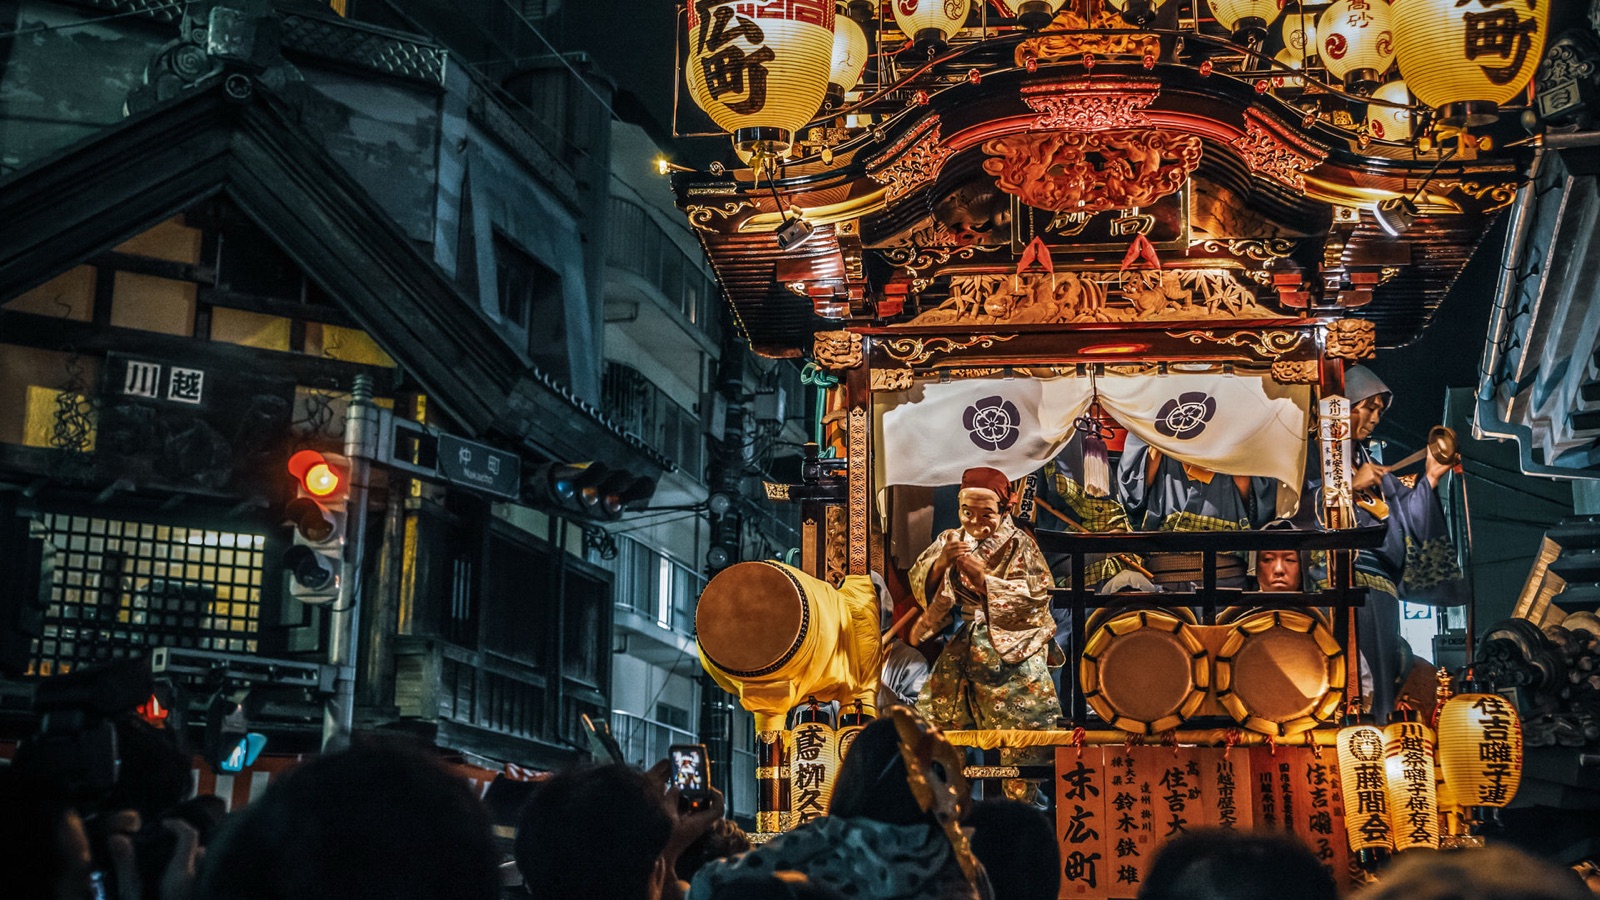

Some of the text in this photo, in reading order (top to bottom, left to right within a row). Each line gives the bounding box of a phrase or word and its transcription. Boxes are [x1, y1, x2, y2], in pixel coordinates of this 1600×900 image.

[1454, 0, 1537, 85] 町
[459, 447, 500, 475] 仲町
[1400, 724, 1432, 843] 川越祭囃子保存会
[1473, 697, 1512, 804] 住吉囃子連
[1061, 761, 1102, 889] 末広町
[1112, 791, 1141, 885] 鈴木鉄雄
[1306, 763, 1334, 864] 住吉囃子
[1354, 763, 1391, 842] 藤間会
